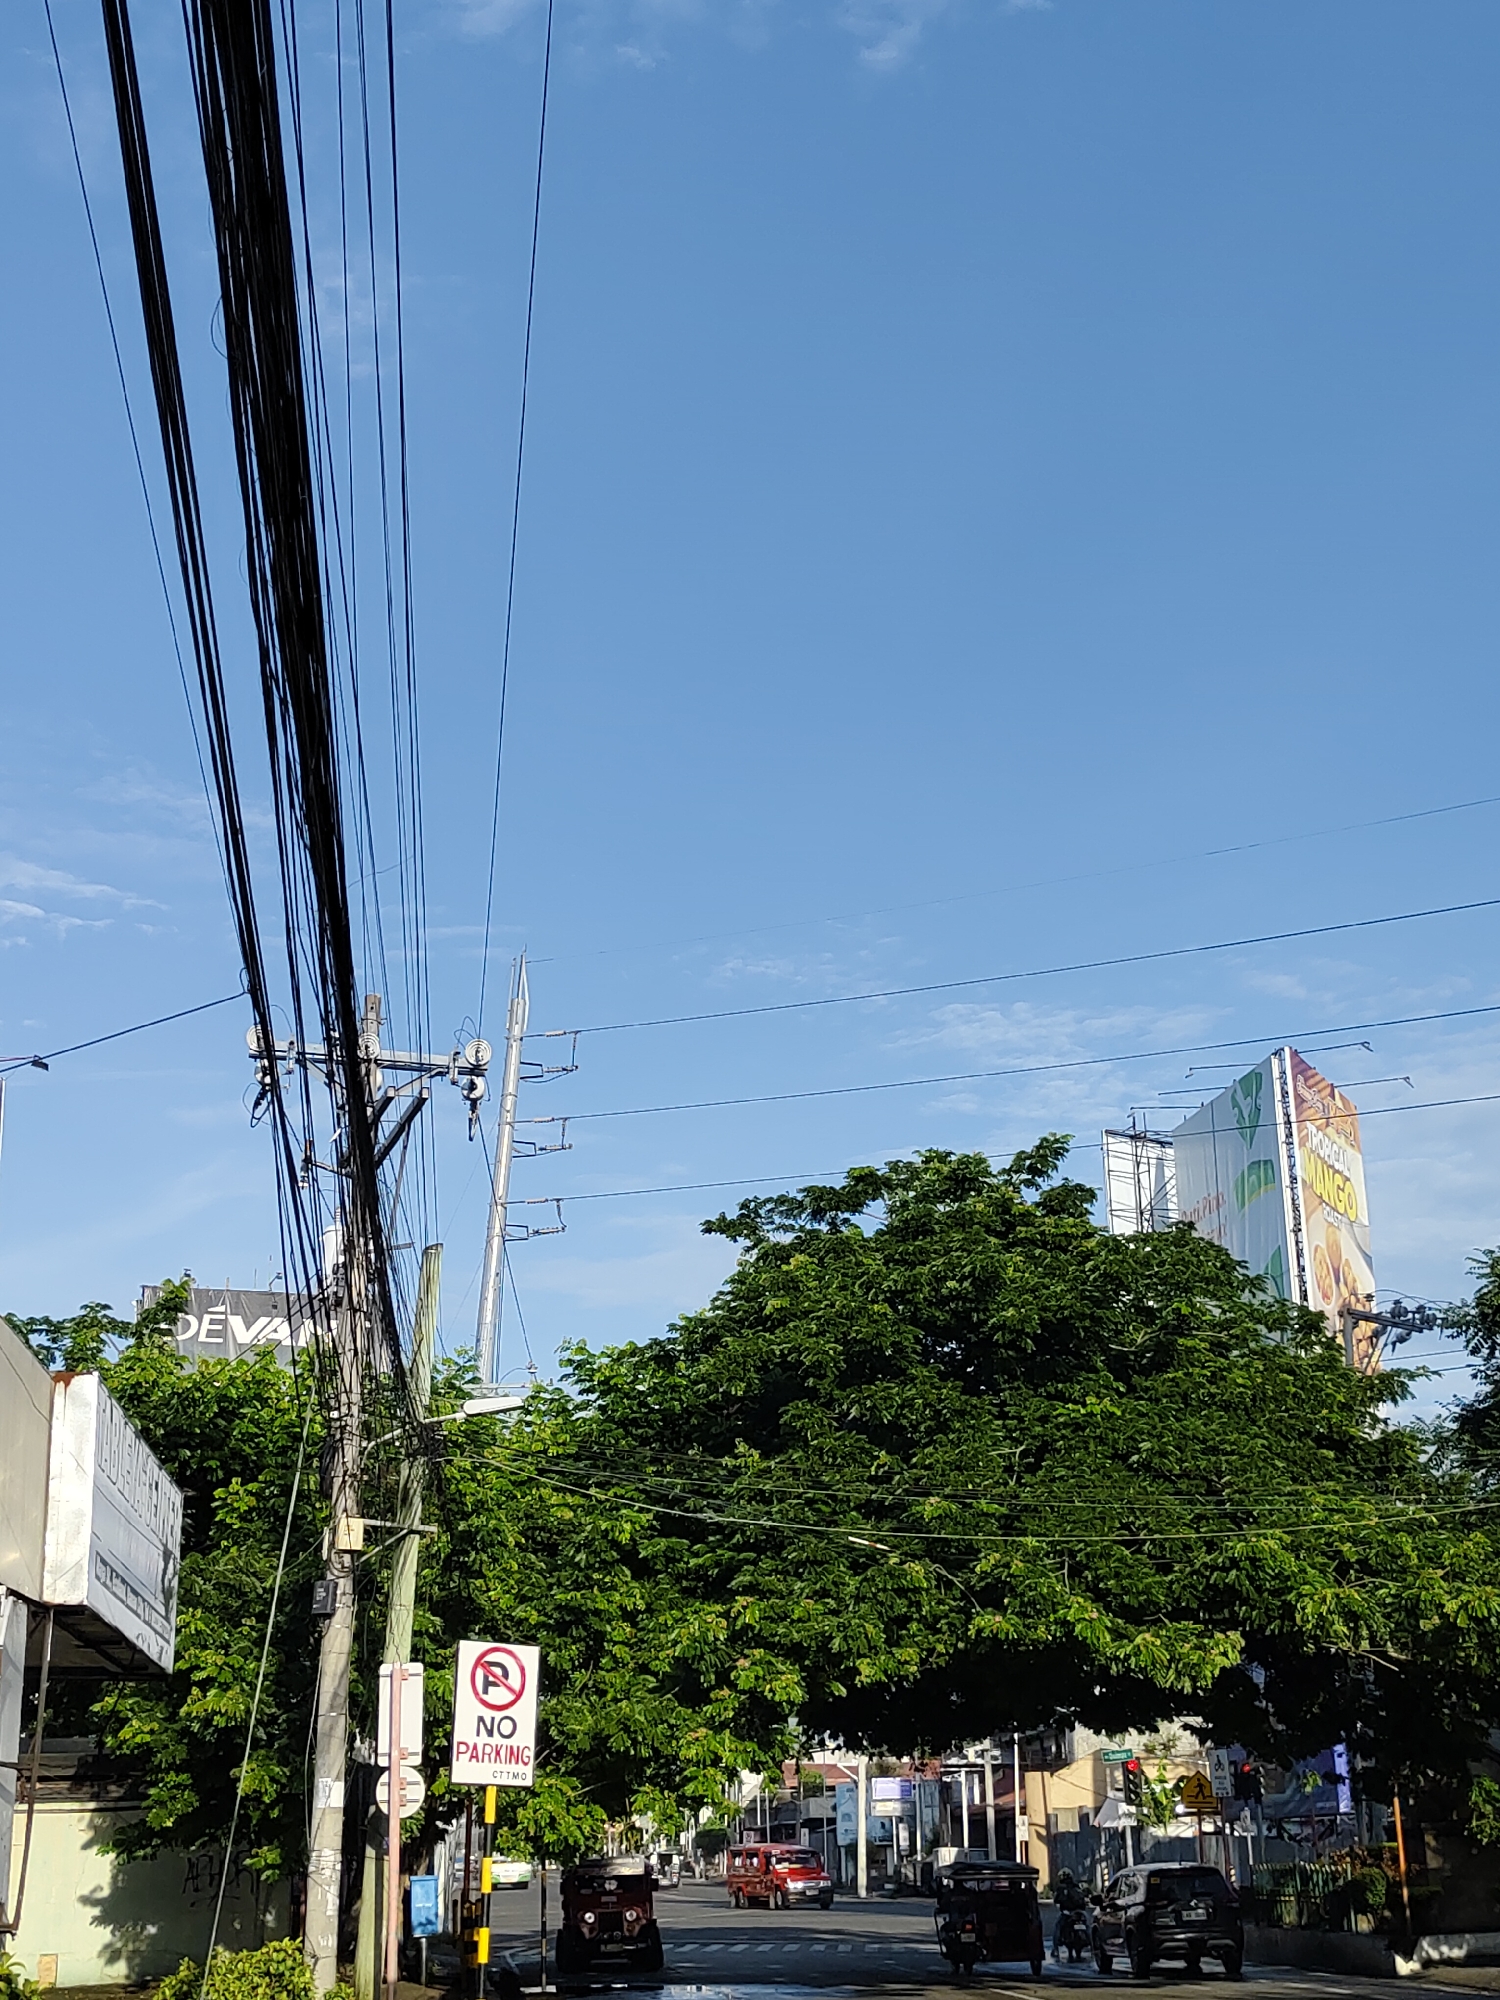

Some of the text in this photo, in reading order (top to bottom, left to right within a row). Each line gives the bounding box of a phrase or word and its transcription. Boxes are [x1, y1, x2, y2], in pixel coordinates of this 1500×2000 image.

[1305, 1121, 1351, 1179] TROPICAL
[1301, 1146, 1358, 1222] MANGO
[475, 1715, 518, 1740] NO
[455, 1741, 532, 1767] PARKING
[492, 1770, 528, 1781] CTTMO
